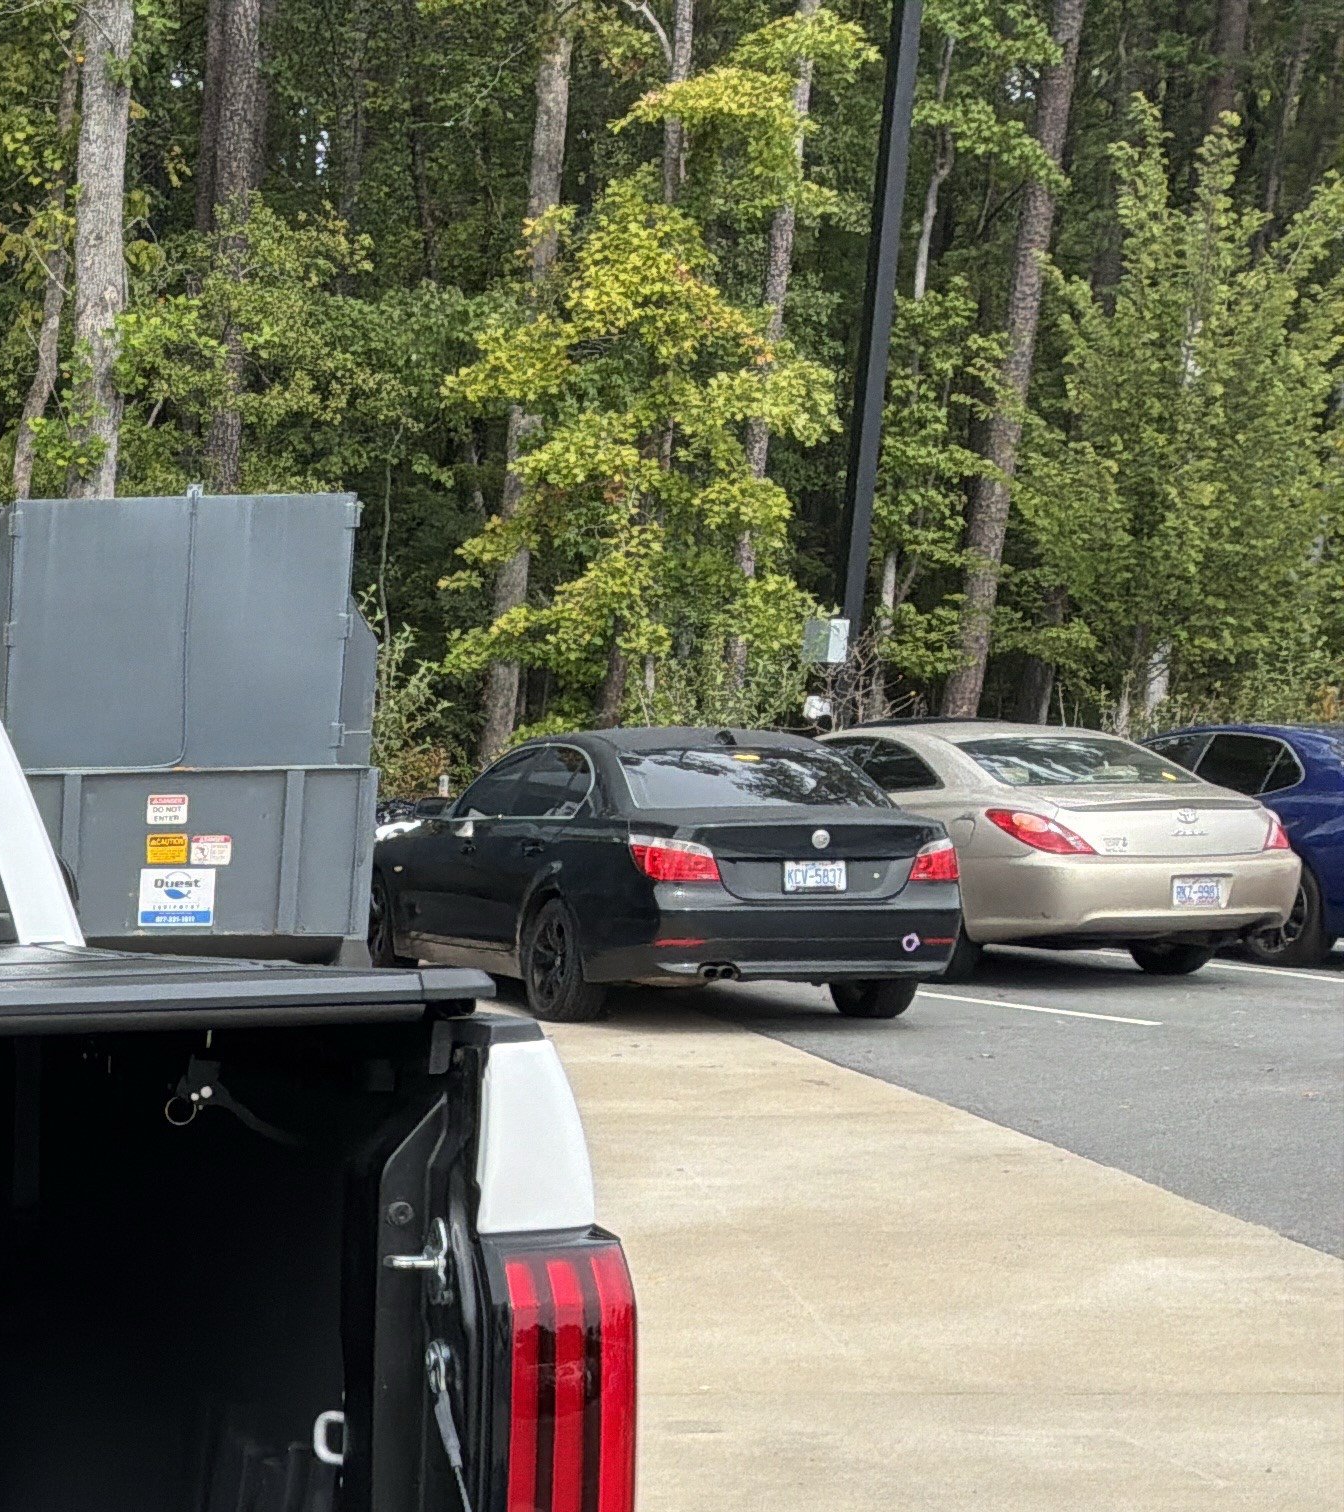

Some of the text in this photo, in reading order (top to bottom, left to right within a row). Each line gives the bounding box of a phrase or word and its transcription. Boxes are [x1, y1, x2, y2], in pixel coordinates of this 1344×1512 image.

[157, 838, 184, 846] CAUTION
[787, 867, 843, 885] KCV-5837
[153, 878, 201, 889] Quest
